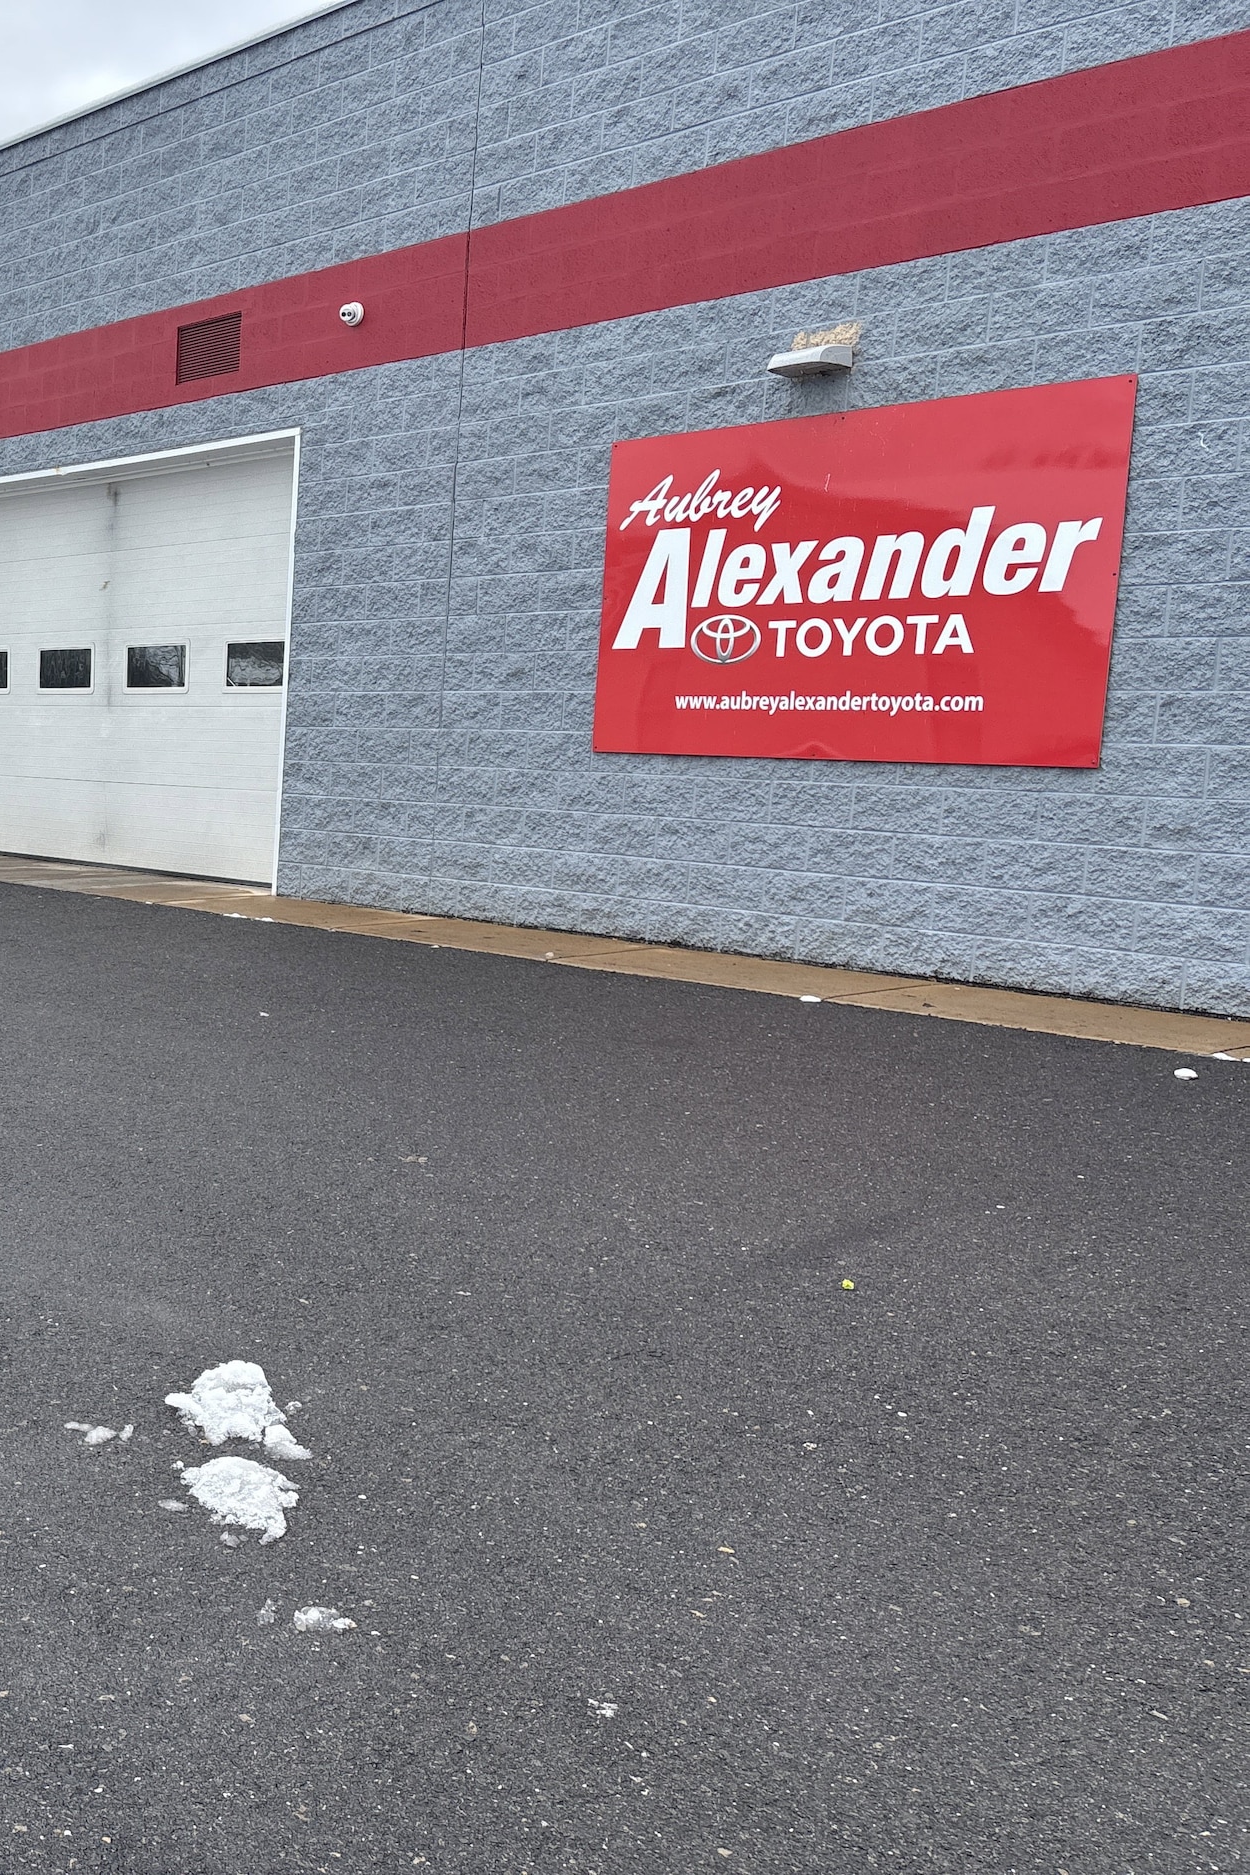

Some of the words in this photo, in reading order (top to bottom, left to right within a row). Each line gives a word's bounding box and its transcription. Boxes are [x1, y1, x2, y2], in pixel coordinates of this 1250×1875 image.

[619, 468, 782, 533] Aubrey
[611, 505, 1104, 650] Alexander
[768, 613, 975, 658] TOYOTA
[675, 690, 984, 717] www.aubreyalexandertoyota.com
